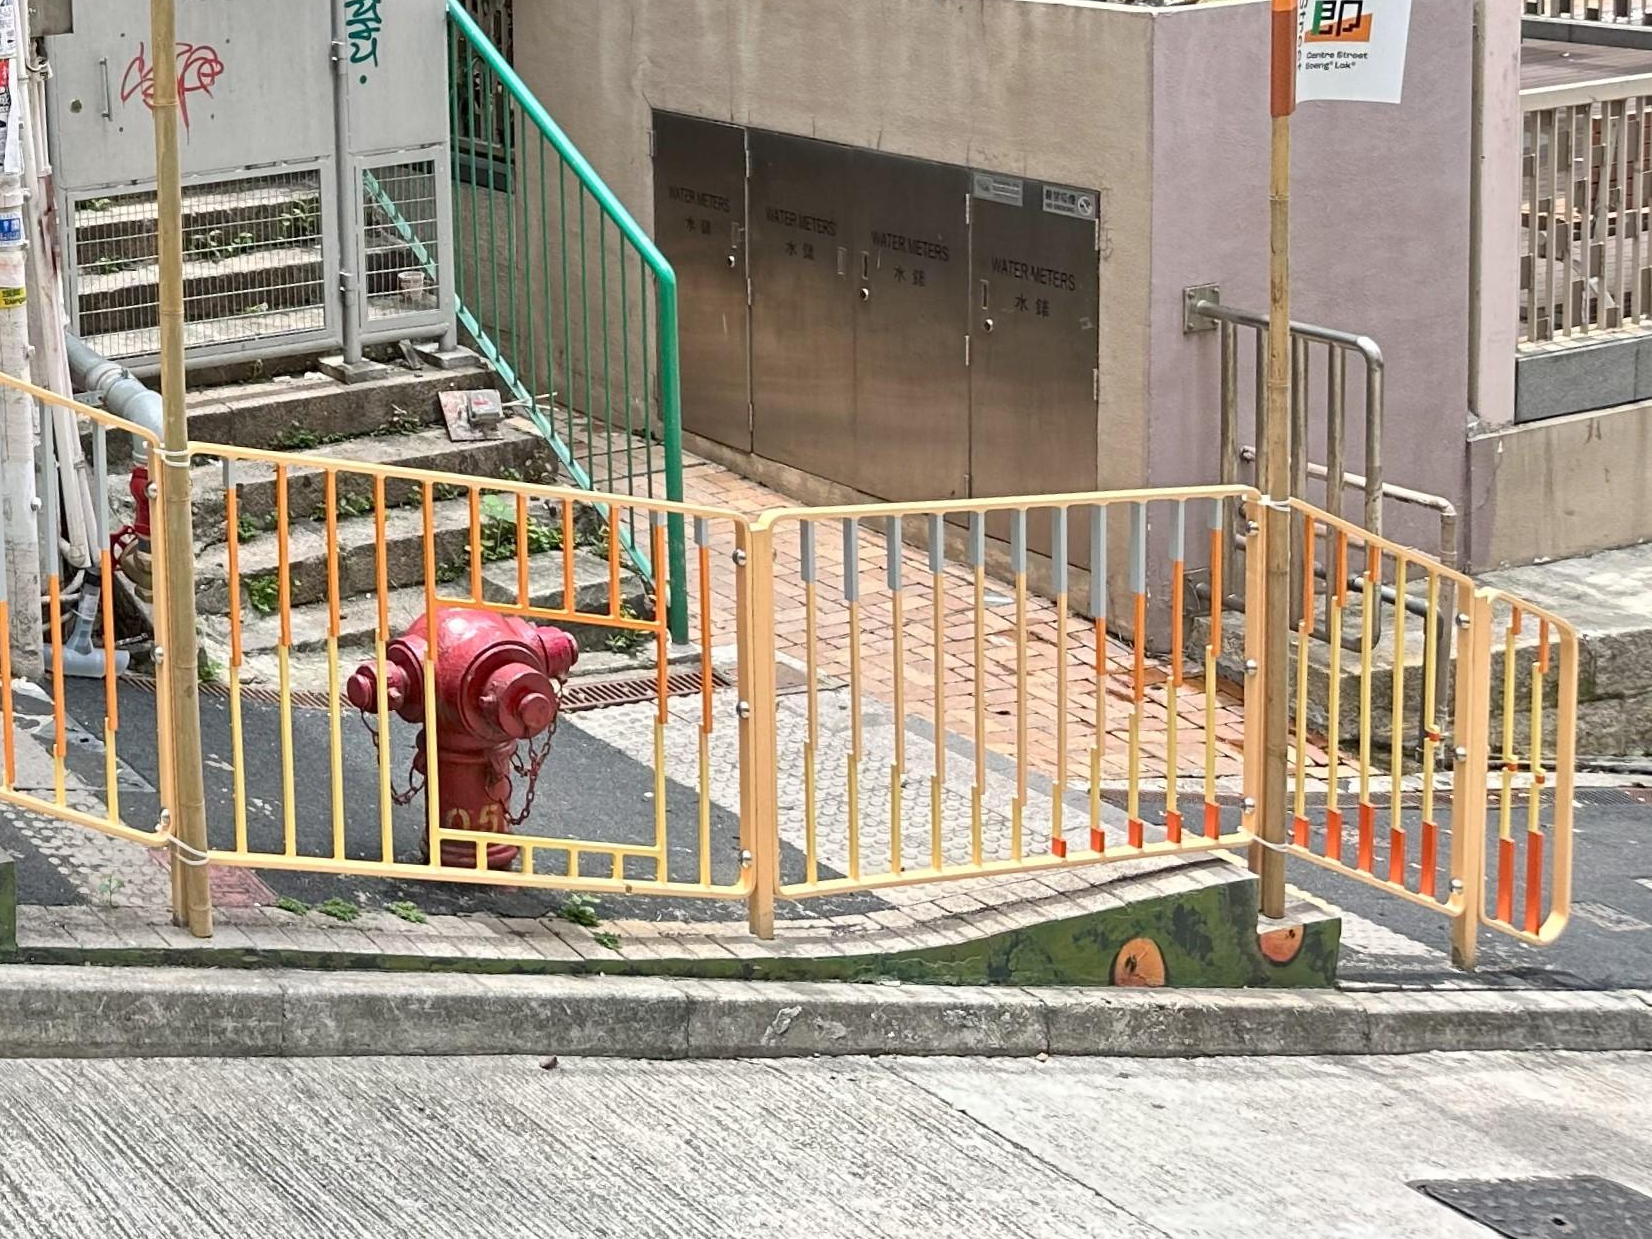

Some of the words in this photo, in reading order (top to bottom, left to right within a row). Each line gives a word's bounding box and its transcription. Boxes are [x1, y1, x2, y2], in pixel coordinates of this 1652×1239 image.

[668, 186, 695, 204] WATER
[697, 191, 731, 213] METERS
[765, 207, 796, 226] WATER
[799, 214, 836, 236] METERS
[871, 230, 904, 251] WATER
[907, 238, 949, 262] METERS
[991, 257, 1028, 279] WATER
[1030, 265, 1076, 291] METERS
